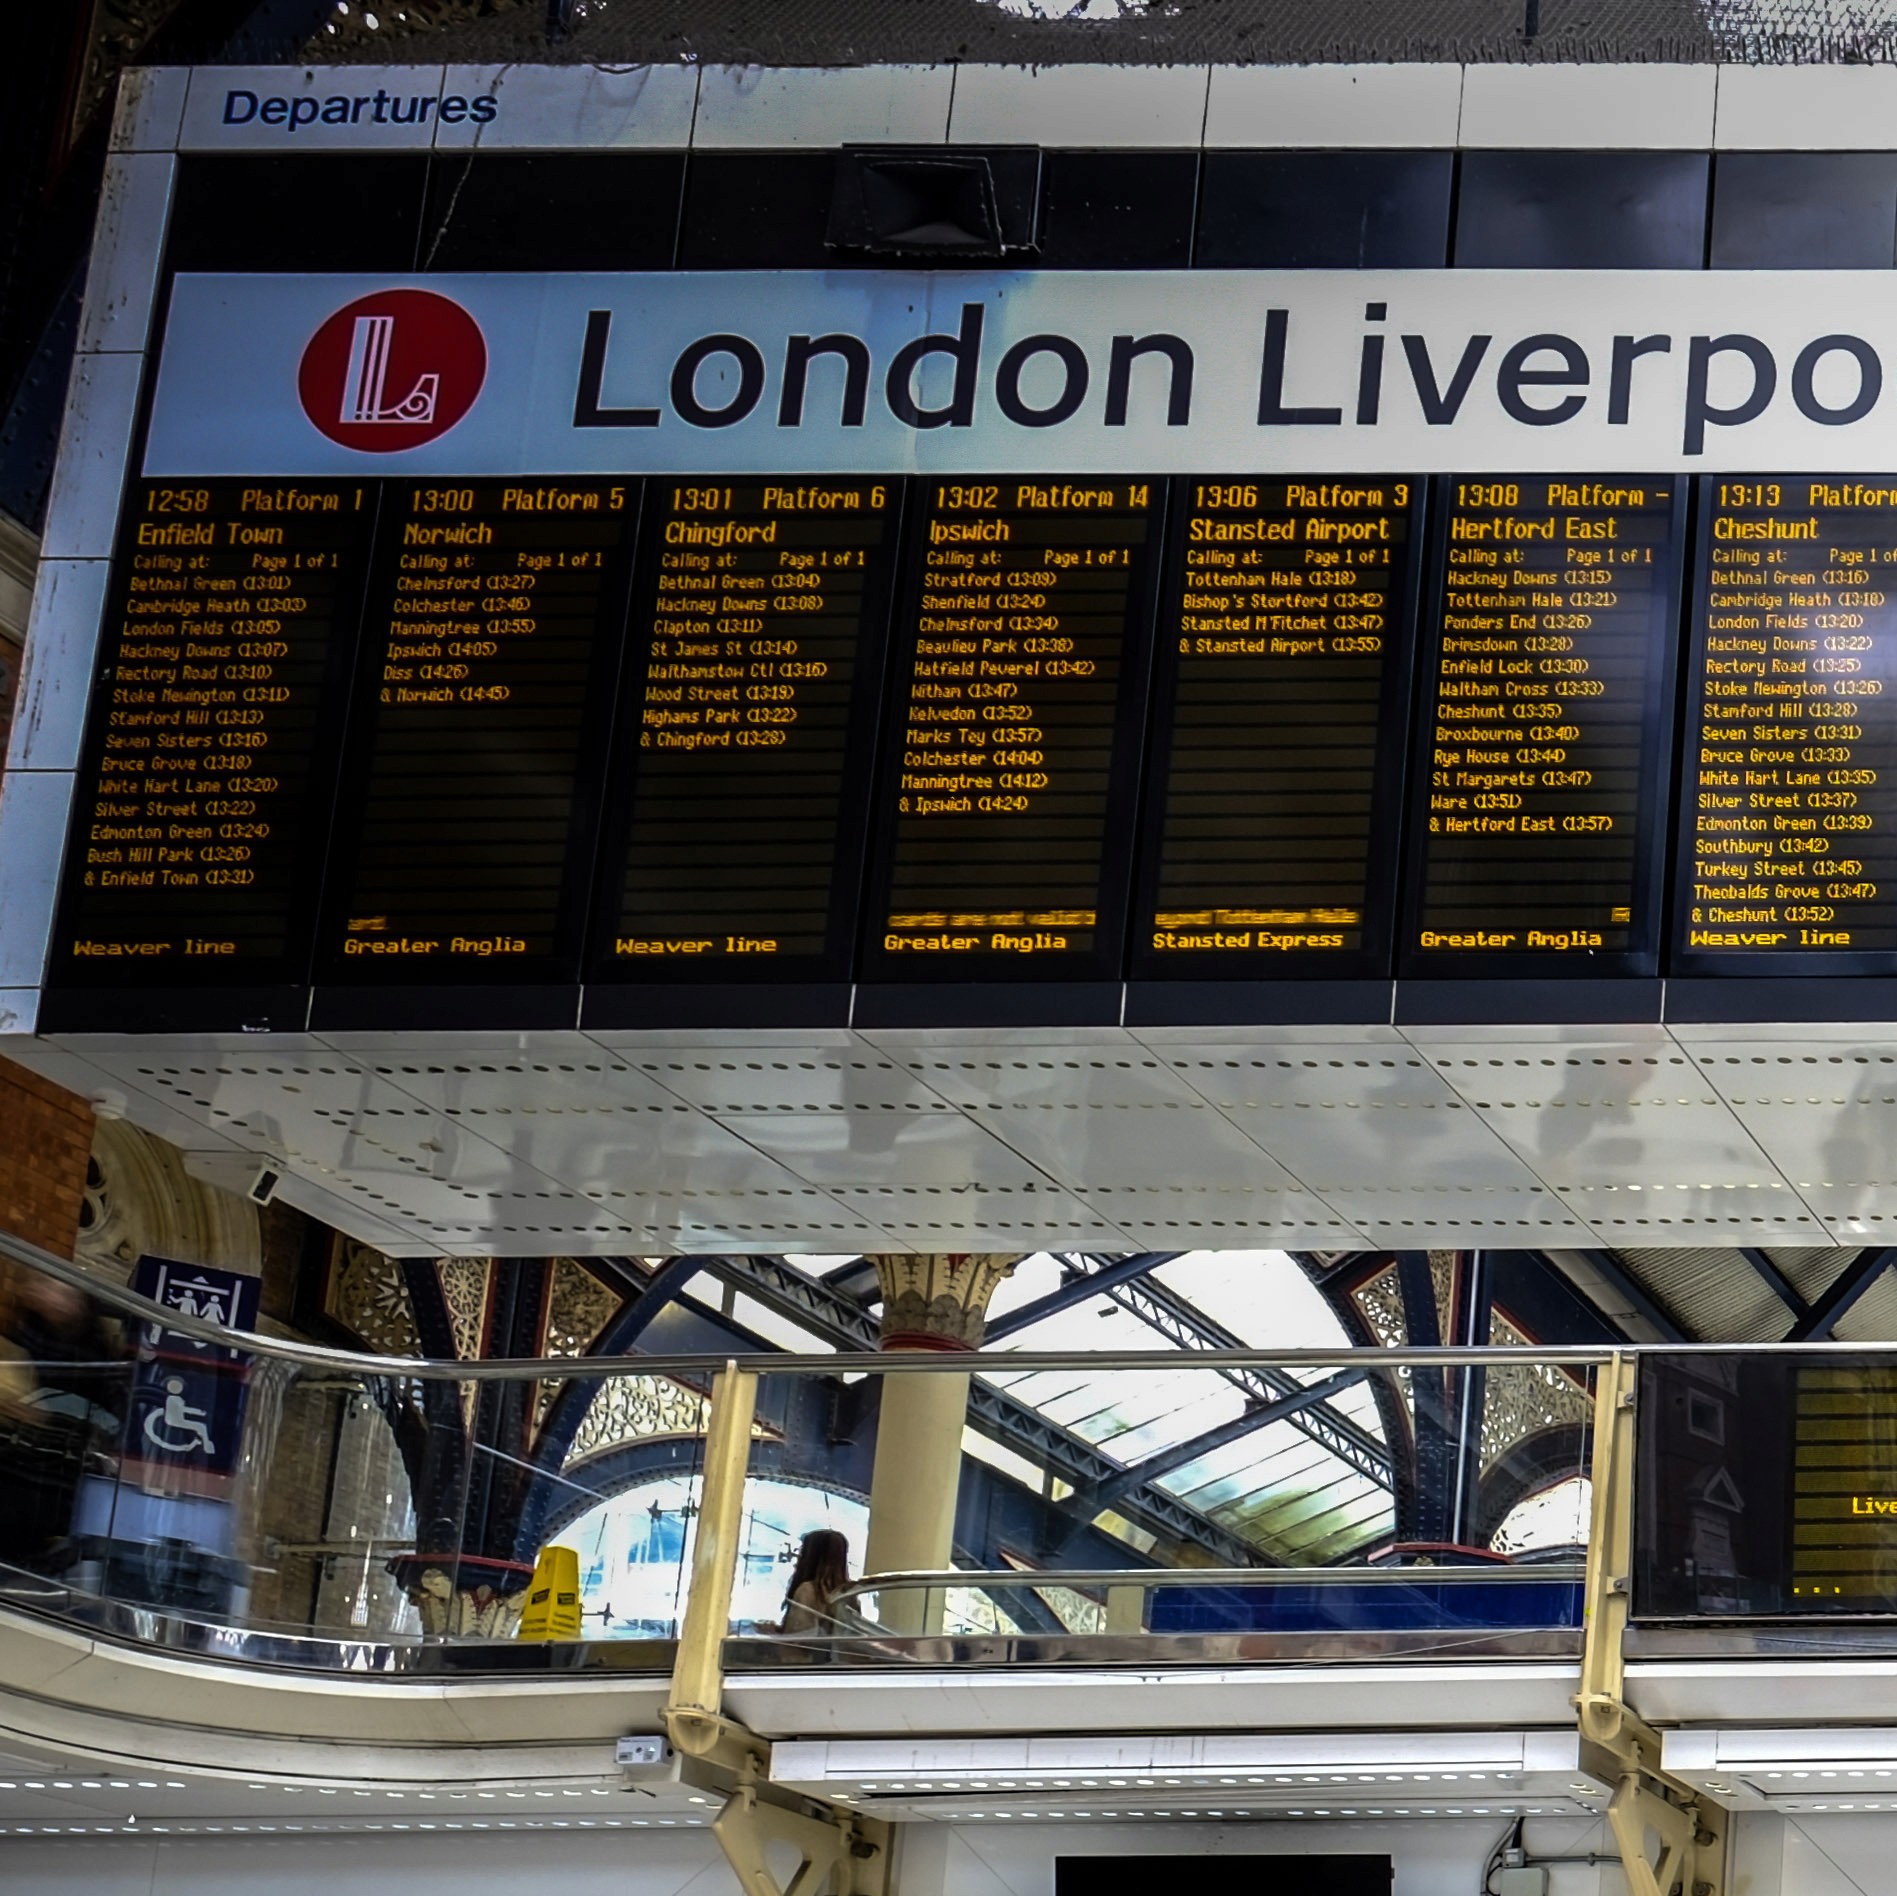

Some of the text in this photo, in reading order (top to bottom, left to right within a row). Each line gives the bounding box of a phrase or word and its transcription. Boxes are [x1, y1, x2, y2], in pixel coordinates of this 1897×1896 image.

[222, 90, 498, 131] Departures
[573, 306, 1195, 429] London
[147, 488, 363, 513] 12:58 Platform 1
[937, 484, 1149, 509] 13:02 Platform 14
[137, 522, 284, 546] Enfield Town
[403, 521, 493, 545] Norwich
[664, 520, 777, 547] Chingford
[929, 518, 1010, 545] Ipswich
[1189, 517, 1390, 544] Stansted Airport
[1451, 516, 1617, 541] Hertford East
[1714, 517, 1818, 540] Cheshunt
[72, 938, 236, 956] Weaver line
[344, 936, 526, 956] Greater Anglia
